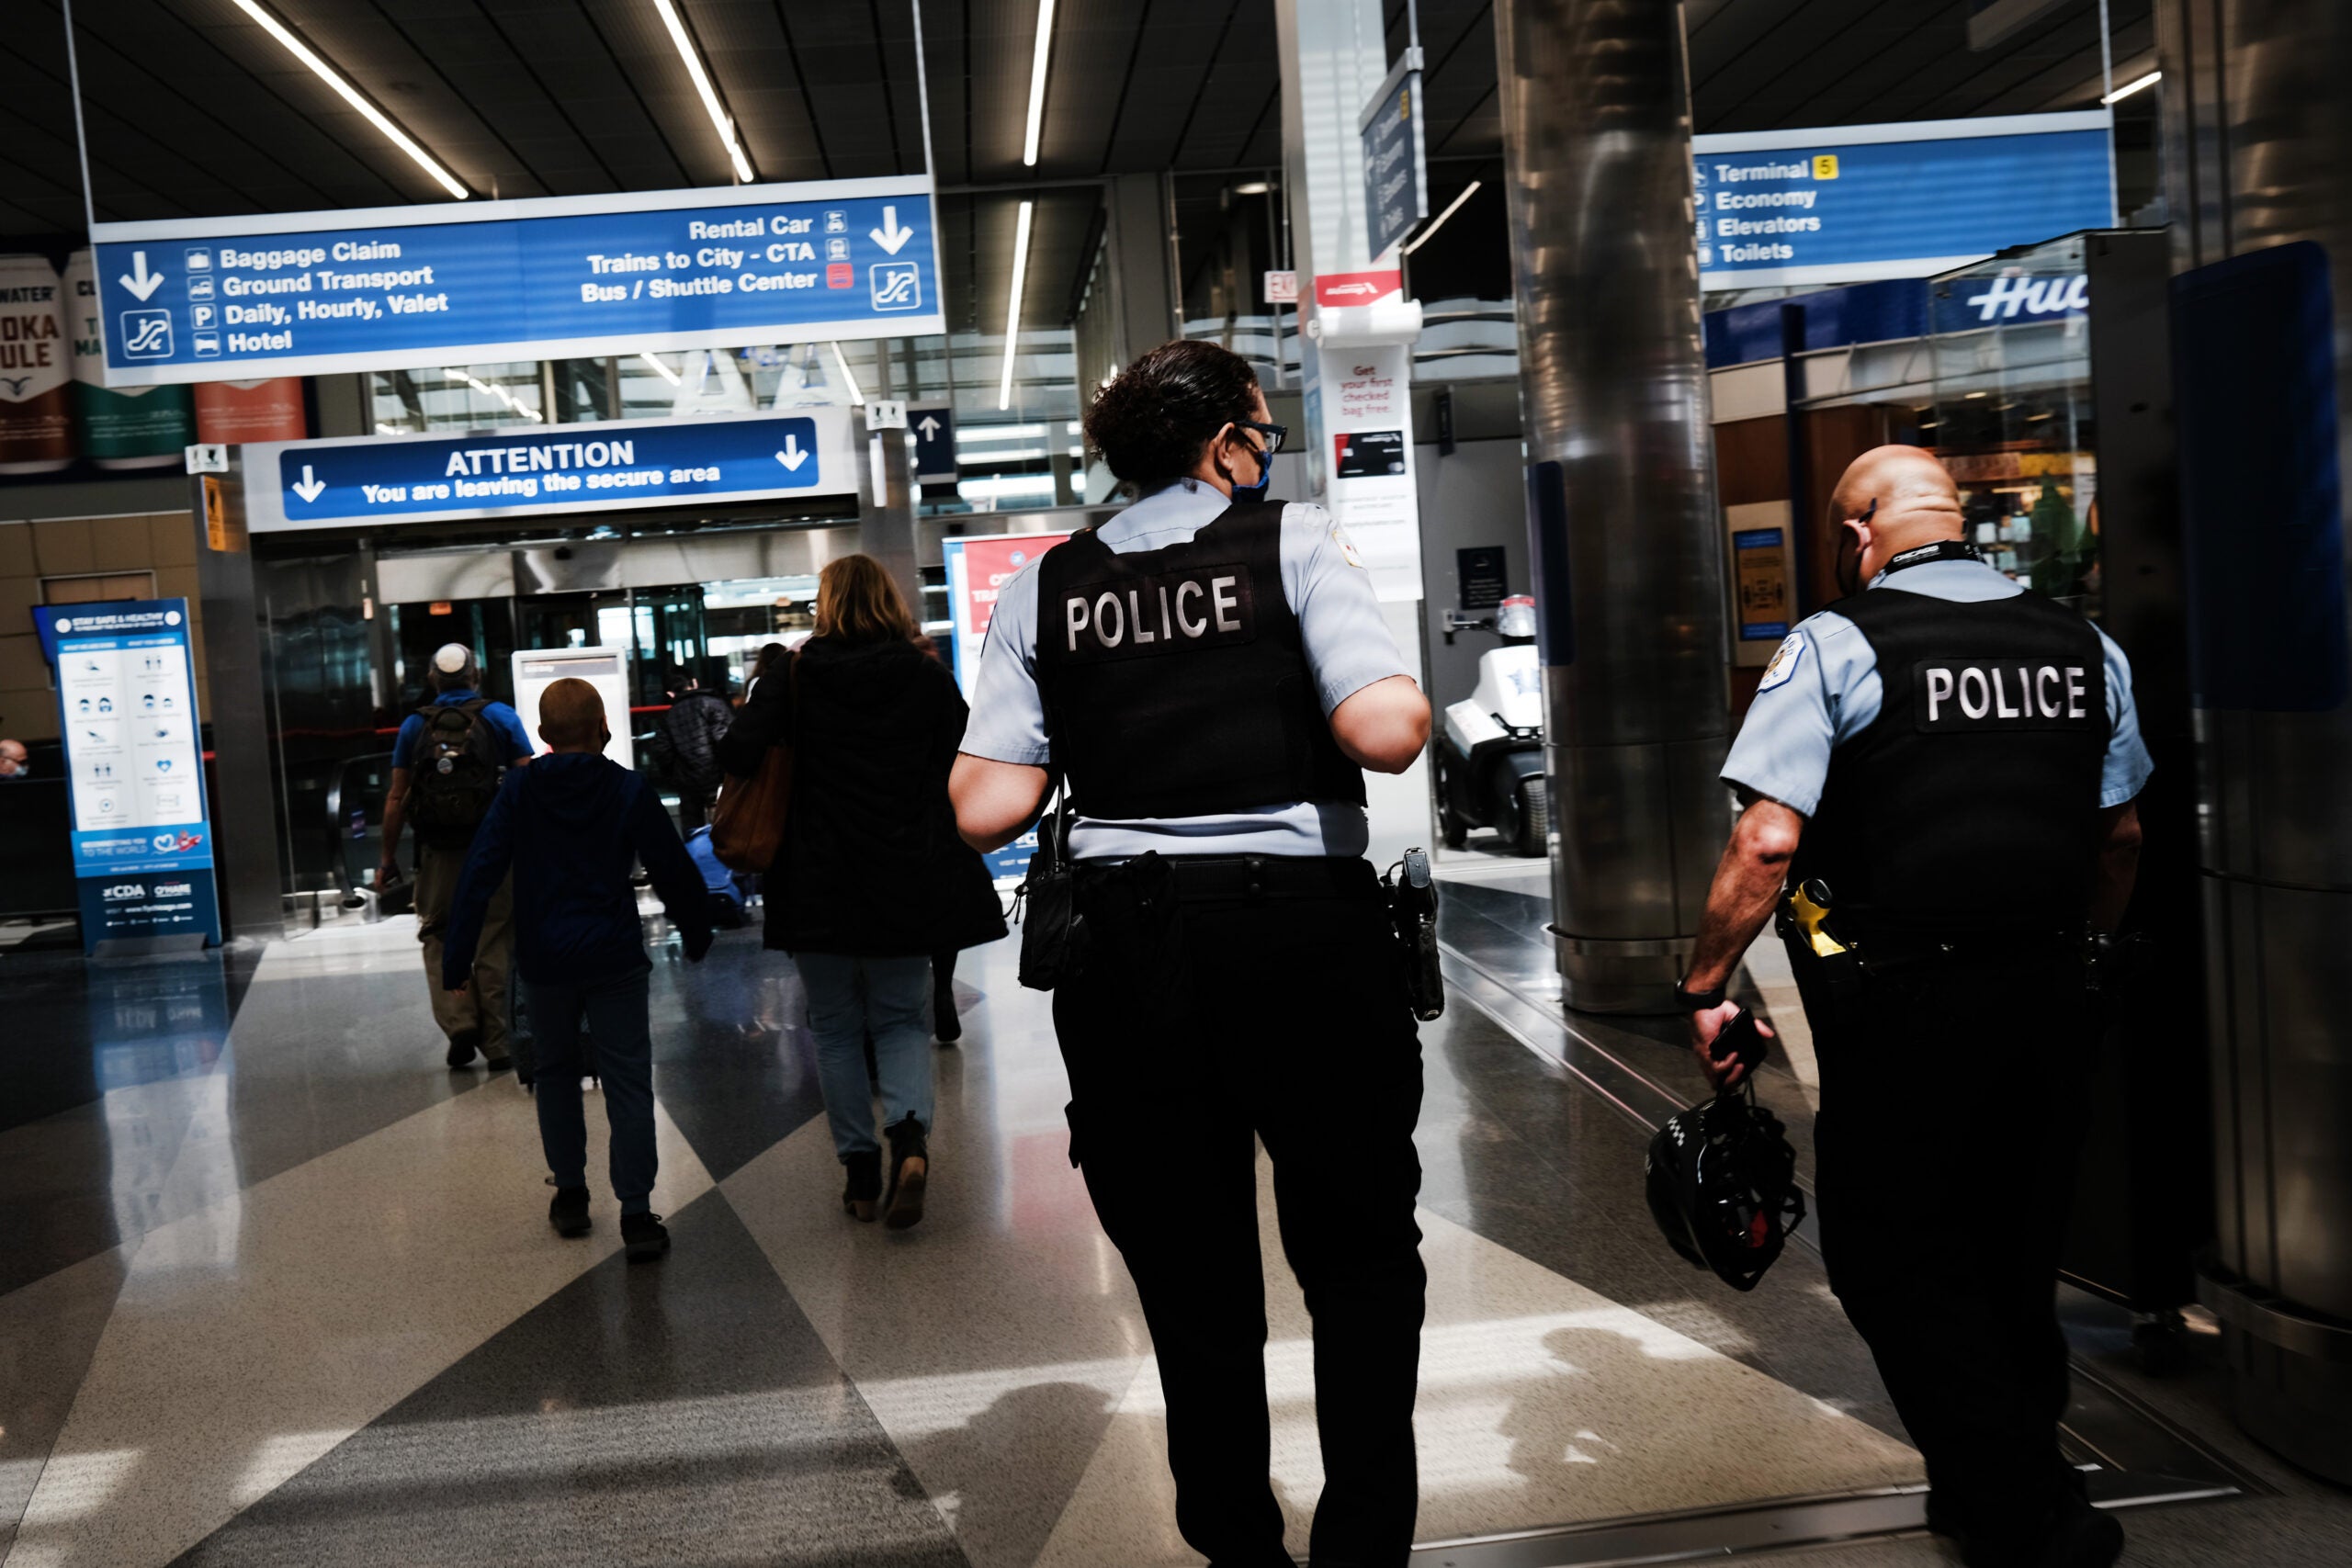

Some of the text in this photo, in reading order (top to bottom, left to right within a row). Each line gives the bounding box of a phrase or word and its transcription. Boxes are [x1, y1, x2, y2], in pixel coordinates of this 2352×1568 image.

[1714, 159, 1832, 183] Terminal 5
[1715, 190, 1817, 210] Economy
[689, 216, 814, 241] Rental Car
[1717, 216, 1821, 237] Elevators
[220, 241, 401, 272] Baggage Claim
[587, 253, 661, 275] Trains
[665, 250, 691, 270] to
[696, 247, 744, 271] City
[766, 243, 817, 263] CTA
[1719, 243, 1794, 263] Toilets
[222, 265, 435, 297] Ground Transport
[581, 282, 628, 303] Bus
[632, 280, 642, 299] /
[649, 275, 733, 299] Shuttle
[738, 271, 818, 292] Center
[225, 293, 449, 327] Daily, Hourly, Valet
[228, 331, 293, 353] Hotel
[1353, 366, 1376, 377] Get
[1340, 378, 1394, 392] your first
[1342, 390, 1390, 402] checked
[1341, 407, 1364, 417] bag
[446, 441, 635, 478] ATTENTION
[361, 466, 720, 505] You are leaving the secure area
[1067, 575, 1242, 651] POLICE
[1926, 666, 2087, 722] POLICE
[96, 846, 114, 856] THE
[115, 845, 148, 855] WORLD
[112, 883, 146, 897] CDA
